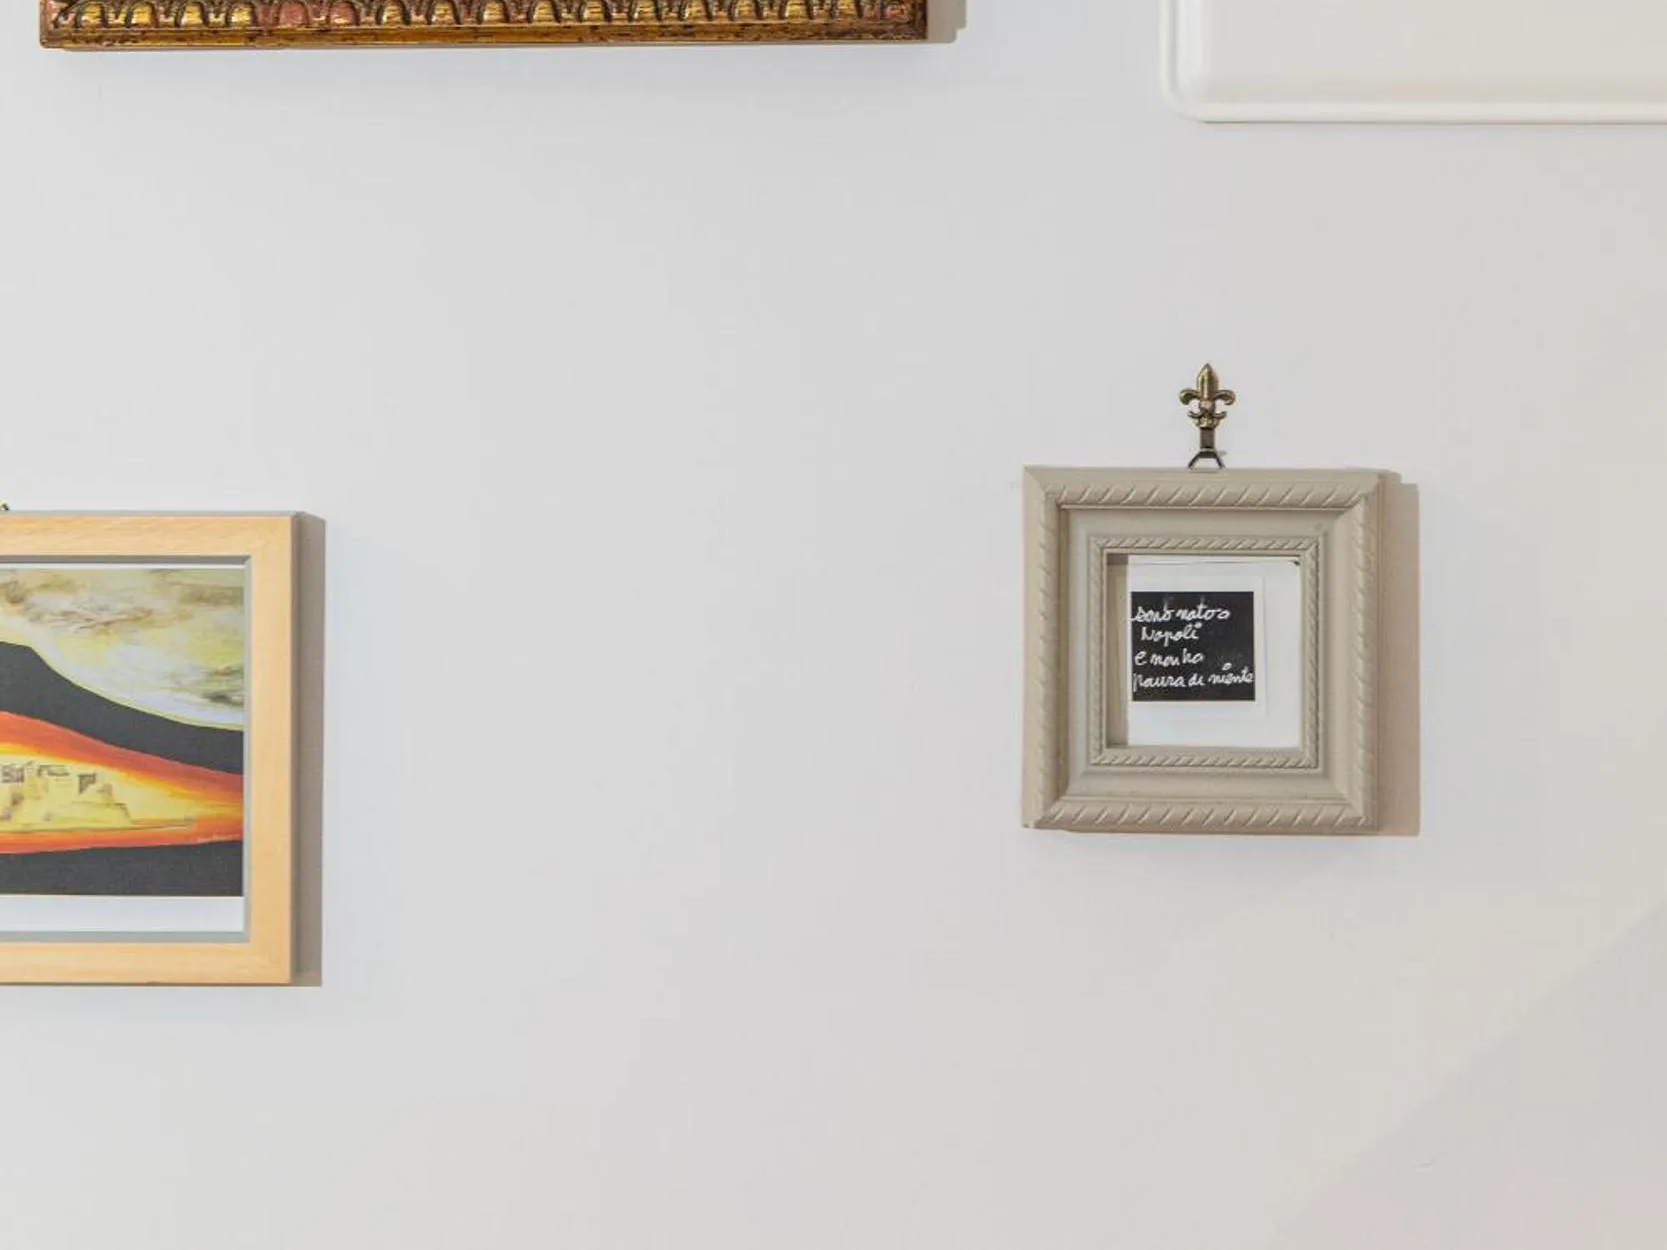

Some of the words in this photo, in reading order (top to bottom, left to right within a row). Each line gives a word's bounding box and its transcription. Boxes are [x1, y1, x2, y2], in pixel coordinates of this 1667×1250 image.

[1149, 652, 1180, 667] non
[1132, 672, 1187, 692] paura
[1188, 673, 1205, 687] di
